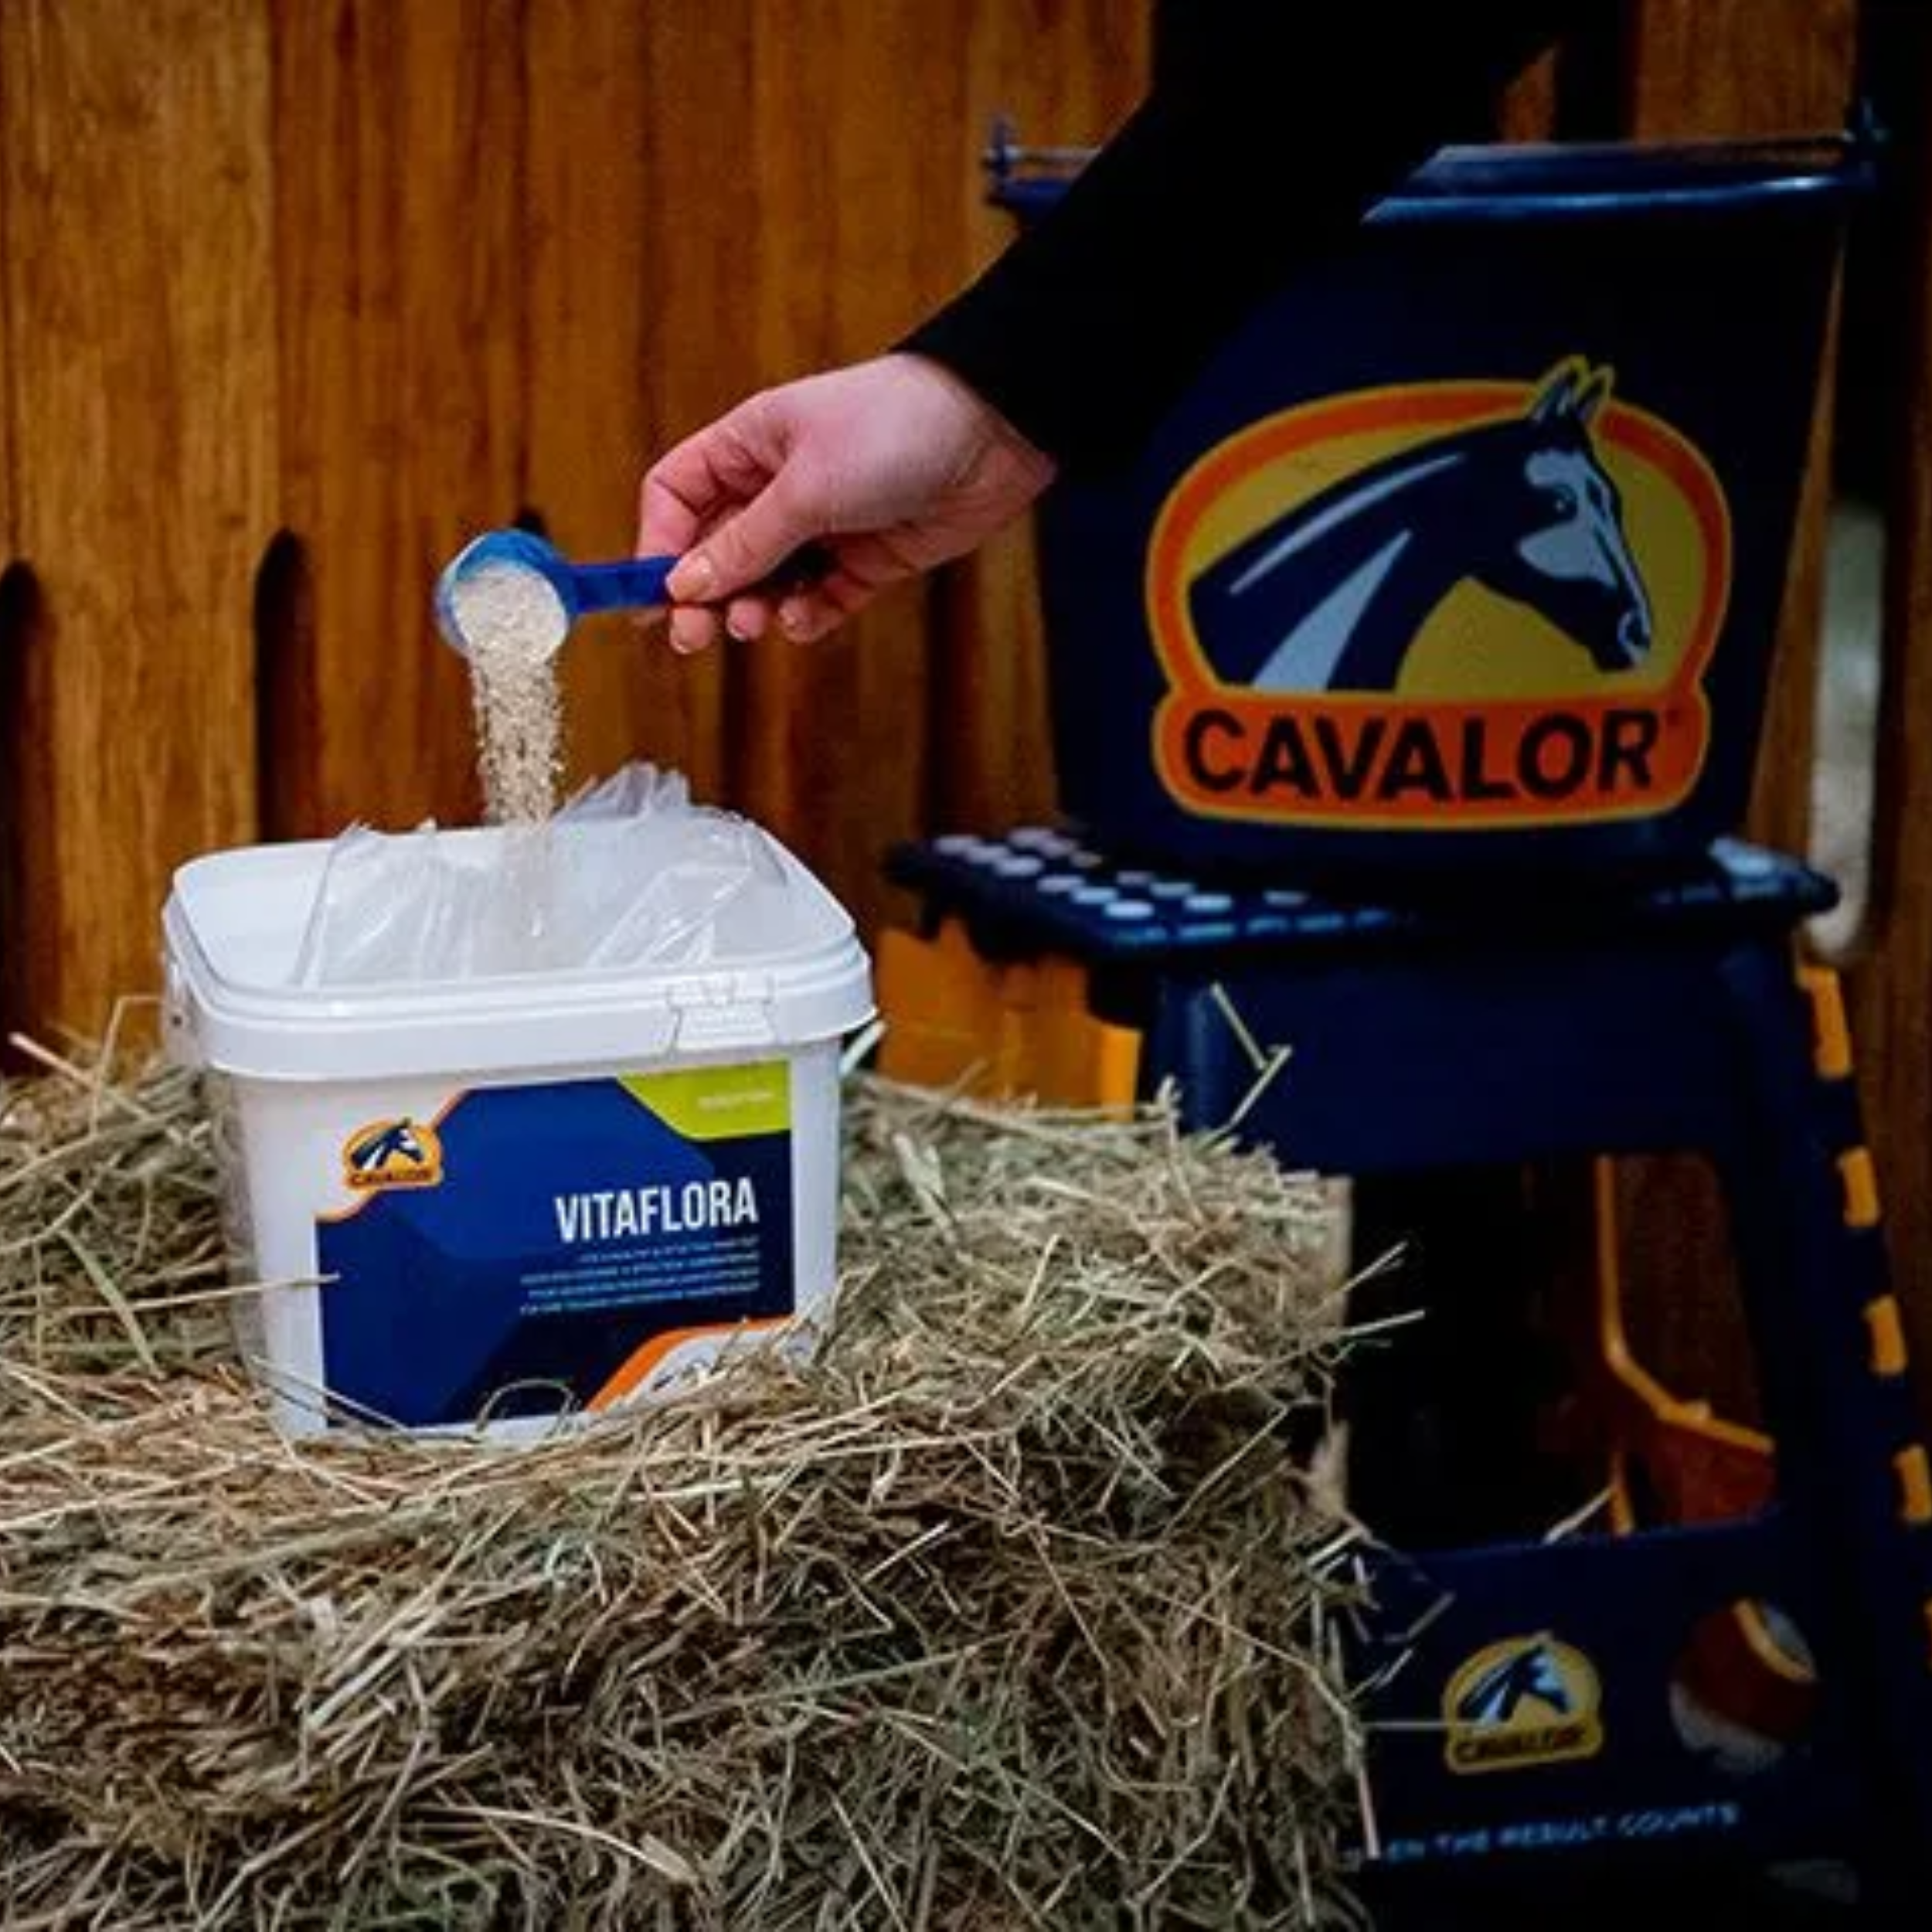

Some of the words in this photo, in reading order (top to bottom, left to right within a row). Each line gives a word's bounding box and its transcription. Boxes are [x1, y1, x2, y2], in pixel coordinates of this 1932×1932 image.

[1184, 708, 1658, 801] CAVALOR
[554, 1177, 760, 1243] VITAFLORA
[1434, 1829, 1489, 1857] THE
[1498, 1815, 1607, 1849] RESULT
